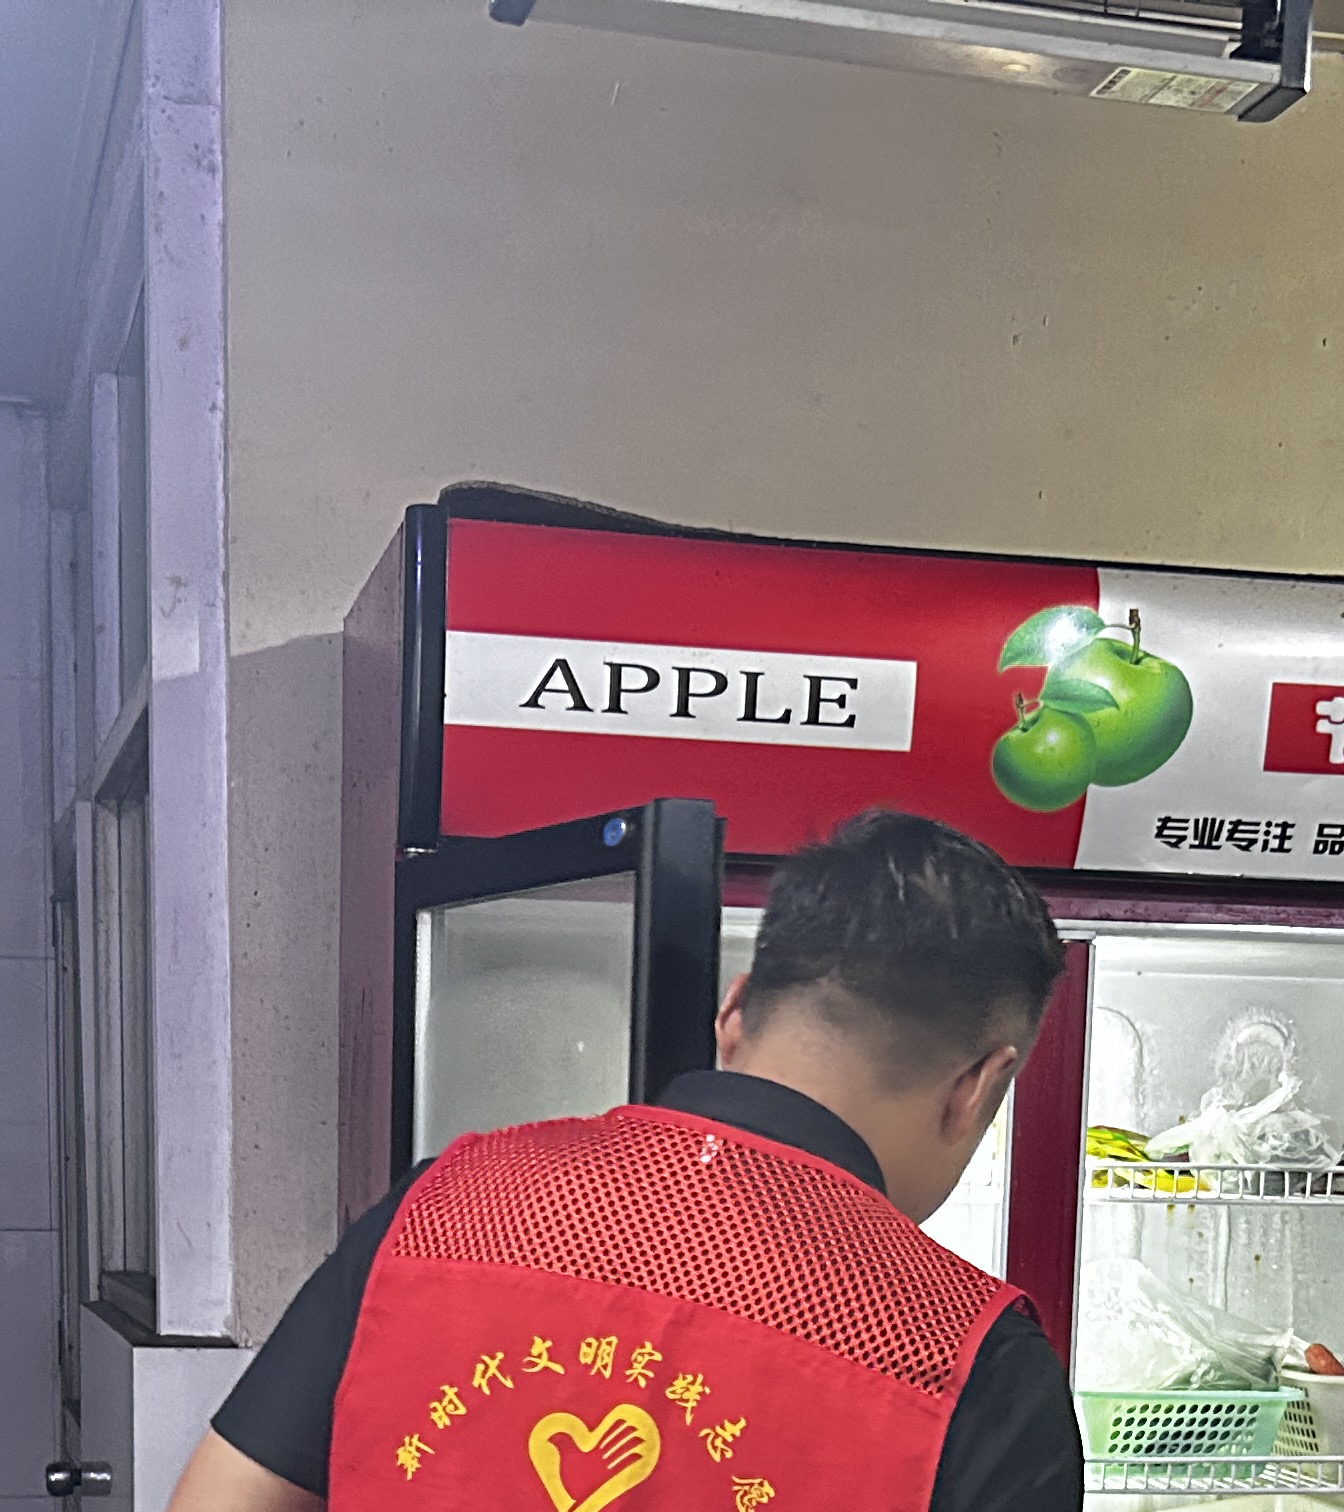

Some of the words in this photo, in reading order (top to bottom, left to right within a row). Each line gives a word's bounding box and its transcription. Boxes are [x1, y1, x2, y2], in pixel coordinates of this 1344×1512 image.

[519, 658, 858, 728] APPLE
[1154, 815, 1296, 854] 专业专注
